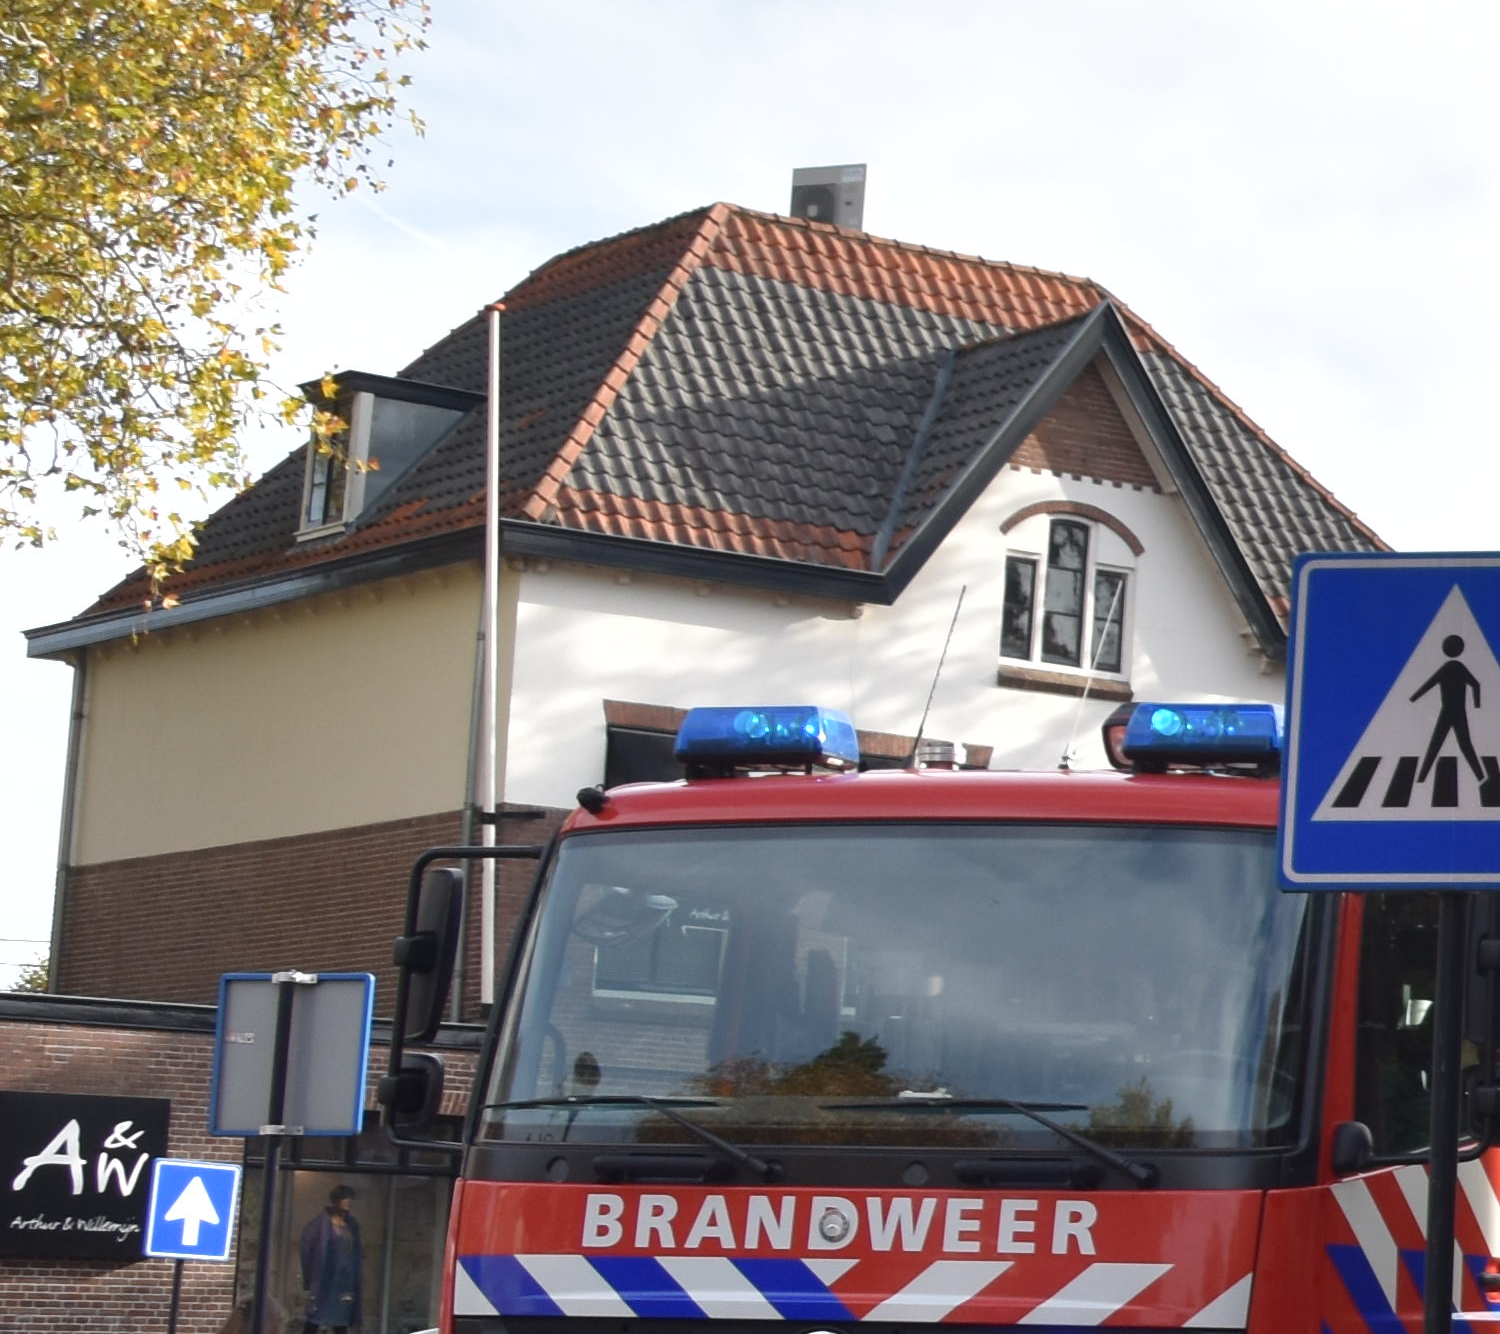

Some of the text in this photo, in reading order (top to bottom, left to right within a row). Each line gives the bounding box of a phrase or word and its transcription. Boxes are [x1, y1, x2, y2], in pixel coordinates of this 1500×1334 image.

[12, 1118, 149, 1197] A & W
[10, 1213, 61, 1231] Arthur
[62, 1216, 73, 1231] &
[581, 1193, 1098, 1255] BRANDWEER
